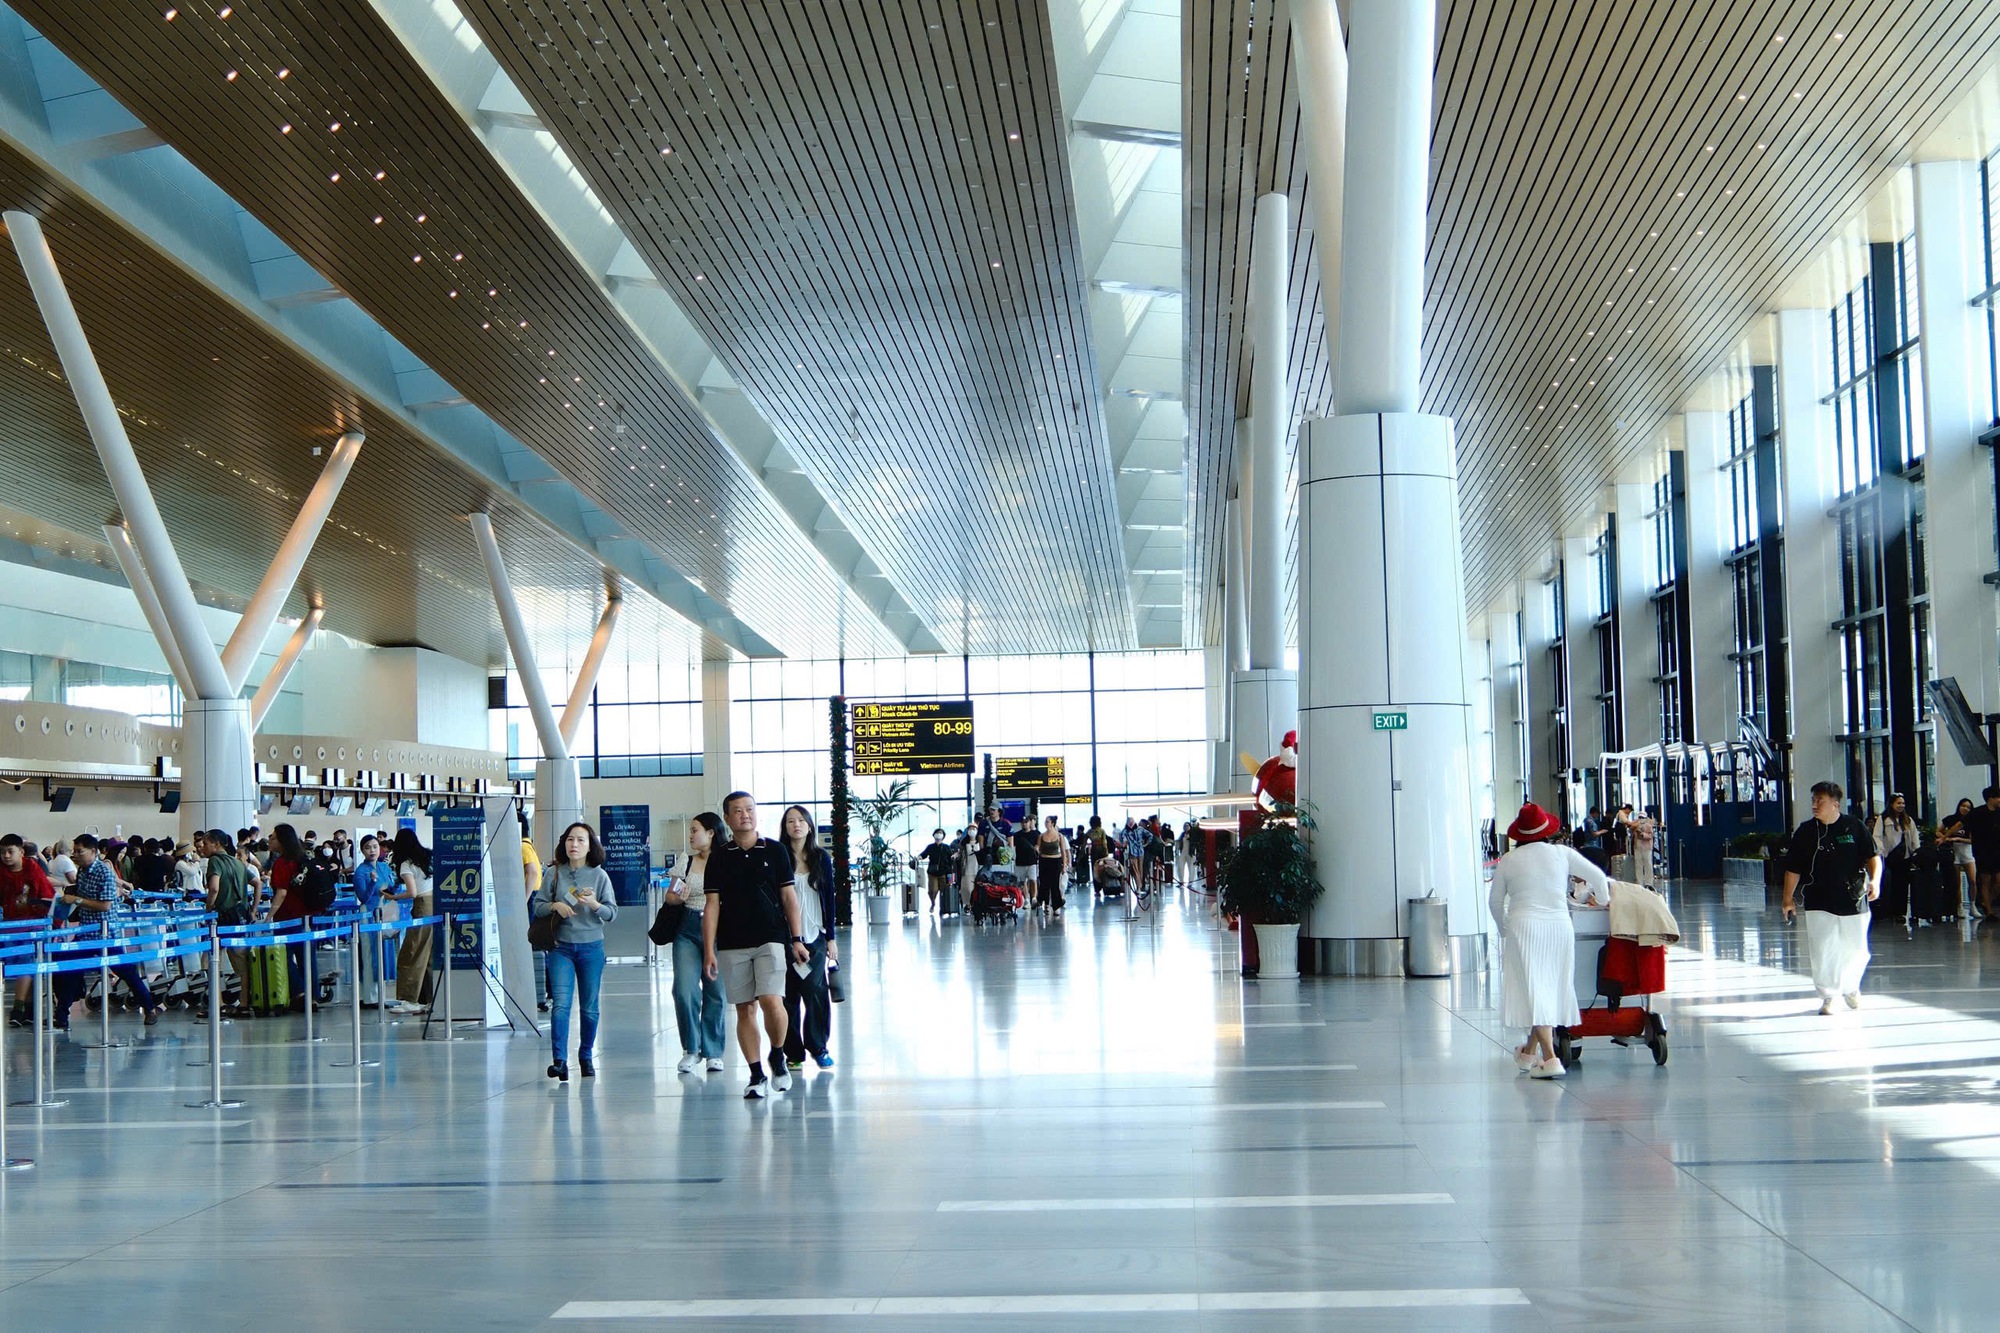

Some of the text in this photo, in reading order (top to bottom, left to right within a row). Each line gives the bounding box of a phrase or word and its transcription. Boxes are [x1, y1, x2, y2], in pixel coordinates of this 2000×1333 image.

[1375, 715, 1398, 728] EXIT
[934, 722, 972, 735] 80-99
[439, 868, 481, 894] 40
